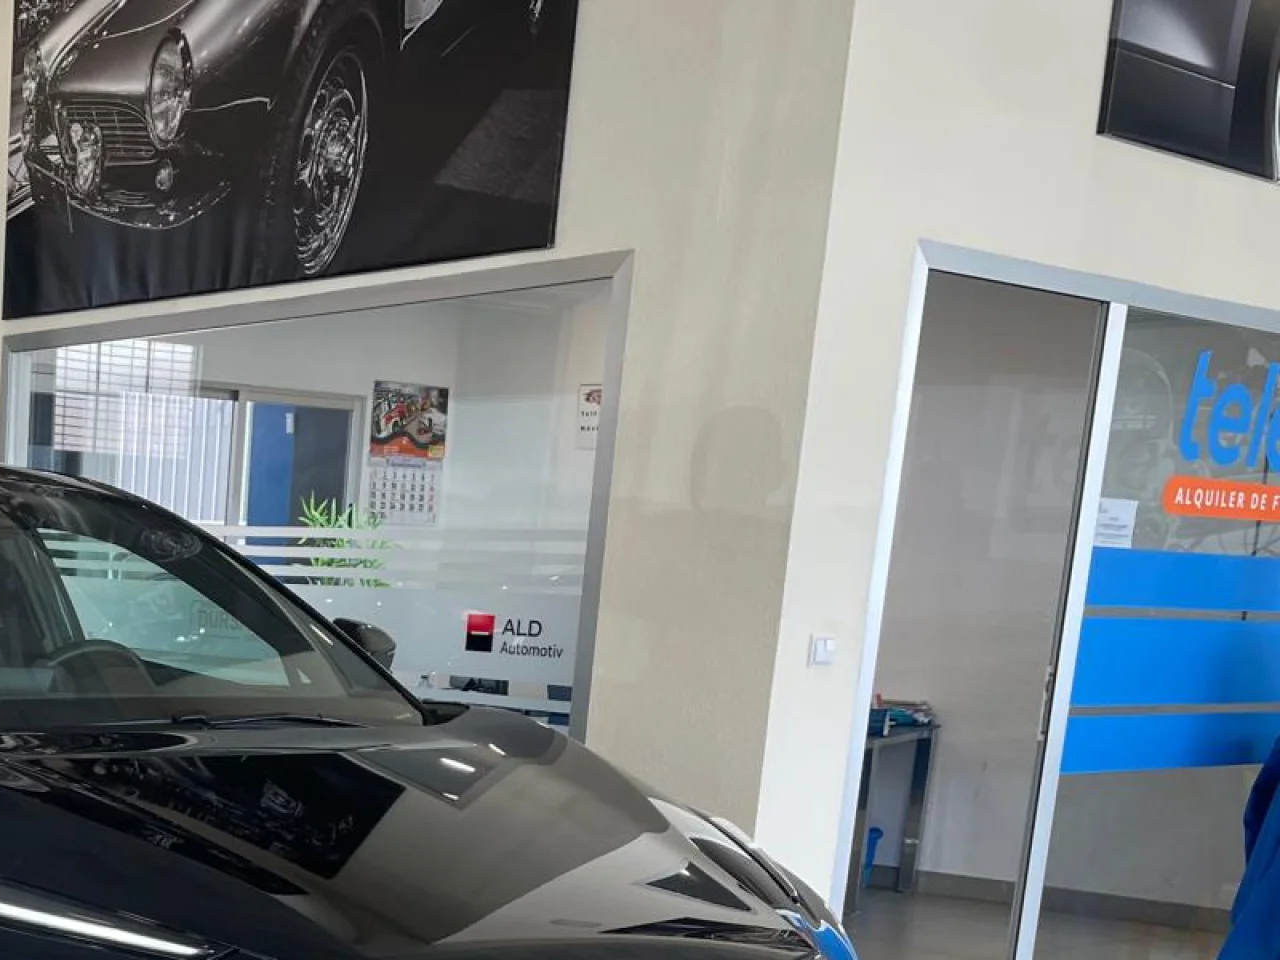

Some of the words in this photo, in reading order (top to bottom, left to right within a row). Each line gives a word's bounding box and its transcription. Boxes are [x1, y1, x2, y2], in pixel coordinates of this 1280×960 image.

[1175, 487, 1245, 509] ALQUILER
[1250, 492, 1268, 511] DE
[502, 618, 542, 637] ALD
[500, 641, 563, 658] Automotiv
